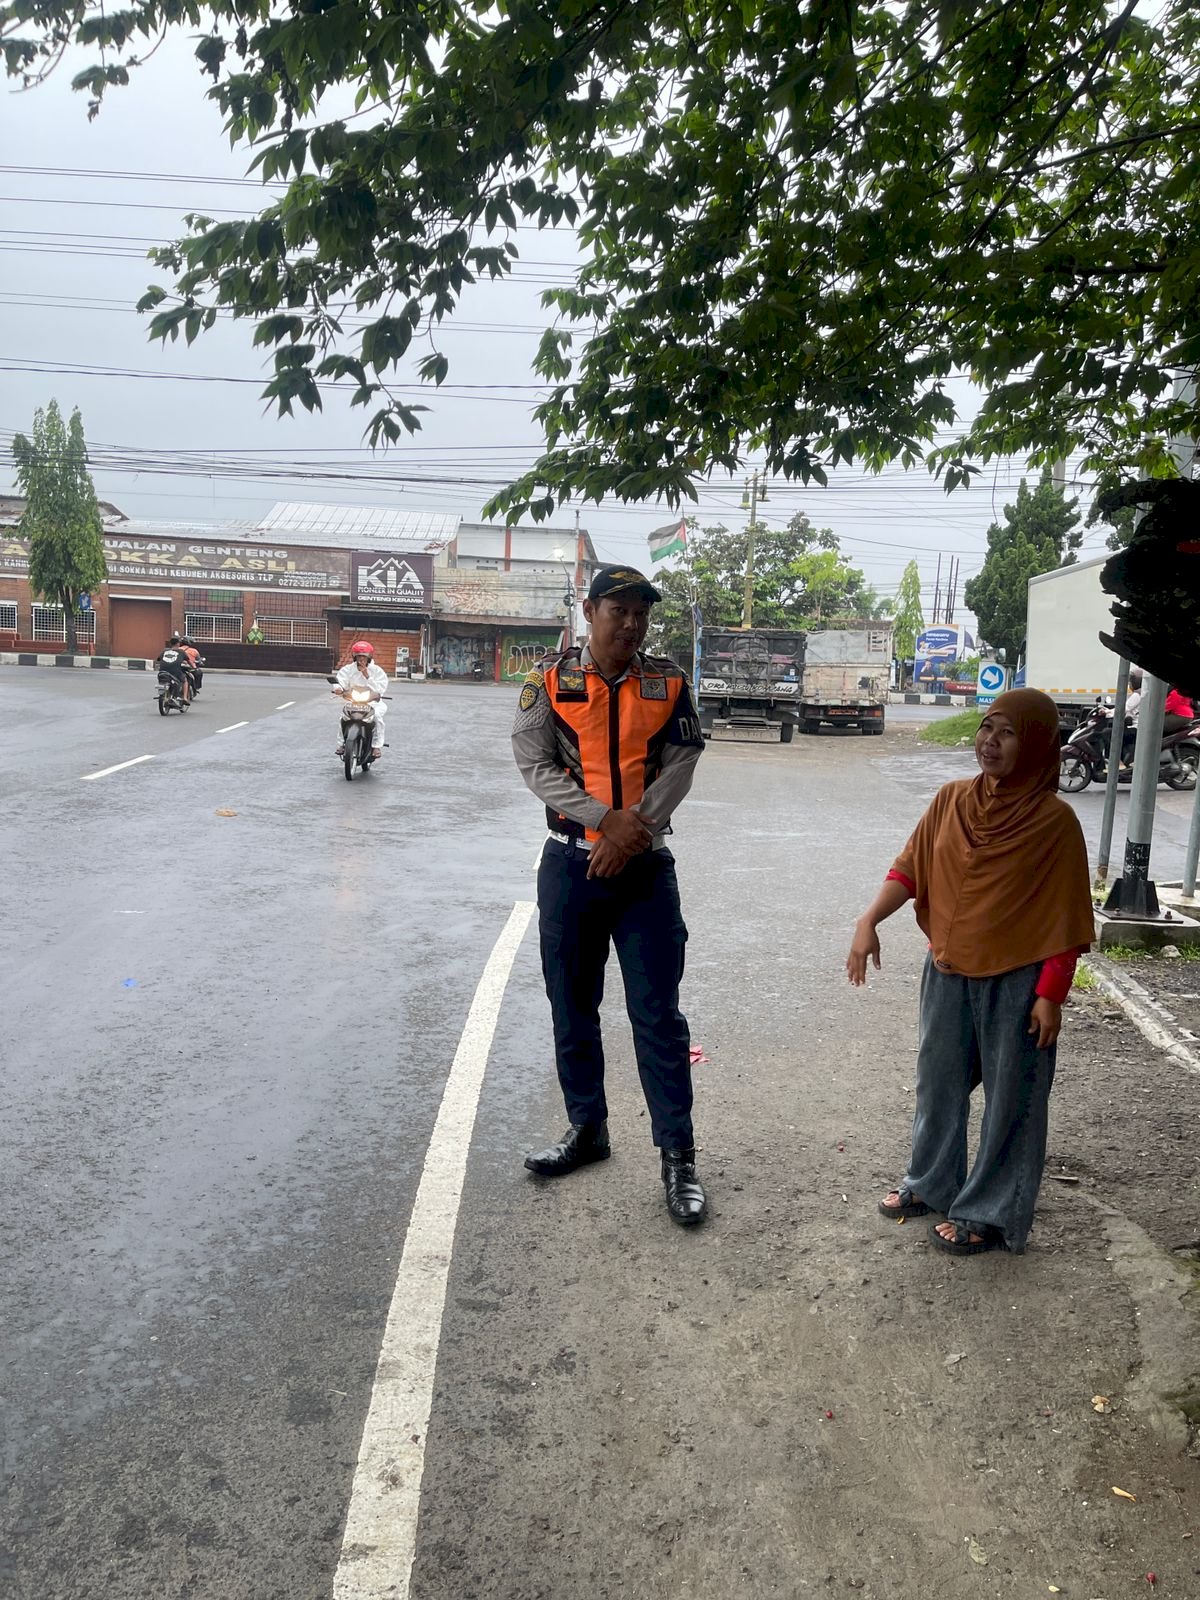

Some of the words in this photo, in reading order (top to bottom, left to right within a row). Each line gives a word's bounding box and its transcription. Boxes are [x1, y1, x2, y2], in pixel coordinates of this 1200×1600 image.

[101, 540, 176, 552] UALAN
[188, 545, 288, 558] GENTENG
[219, 557, 296, 572] ASLI
[119, 566, 146, 575] SOKKA
[149, 567, 168, 576] ASLI
[257, 573, 274, 582] TLP
[357, 565, 424, 590] KIA
[357, 586, 386, 594] PIONEER
[396, 589, 424, 597] QUALITY
[978, 696, 995, 704] MAS
[678, 716, 702, 741] DA
